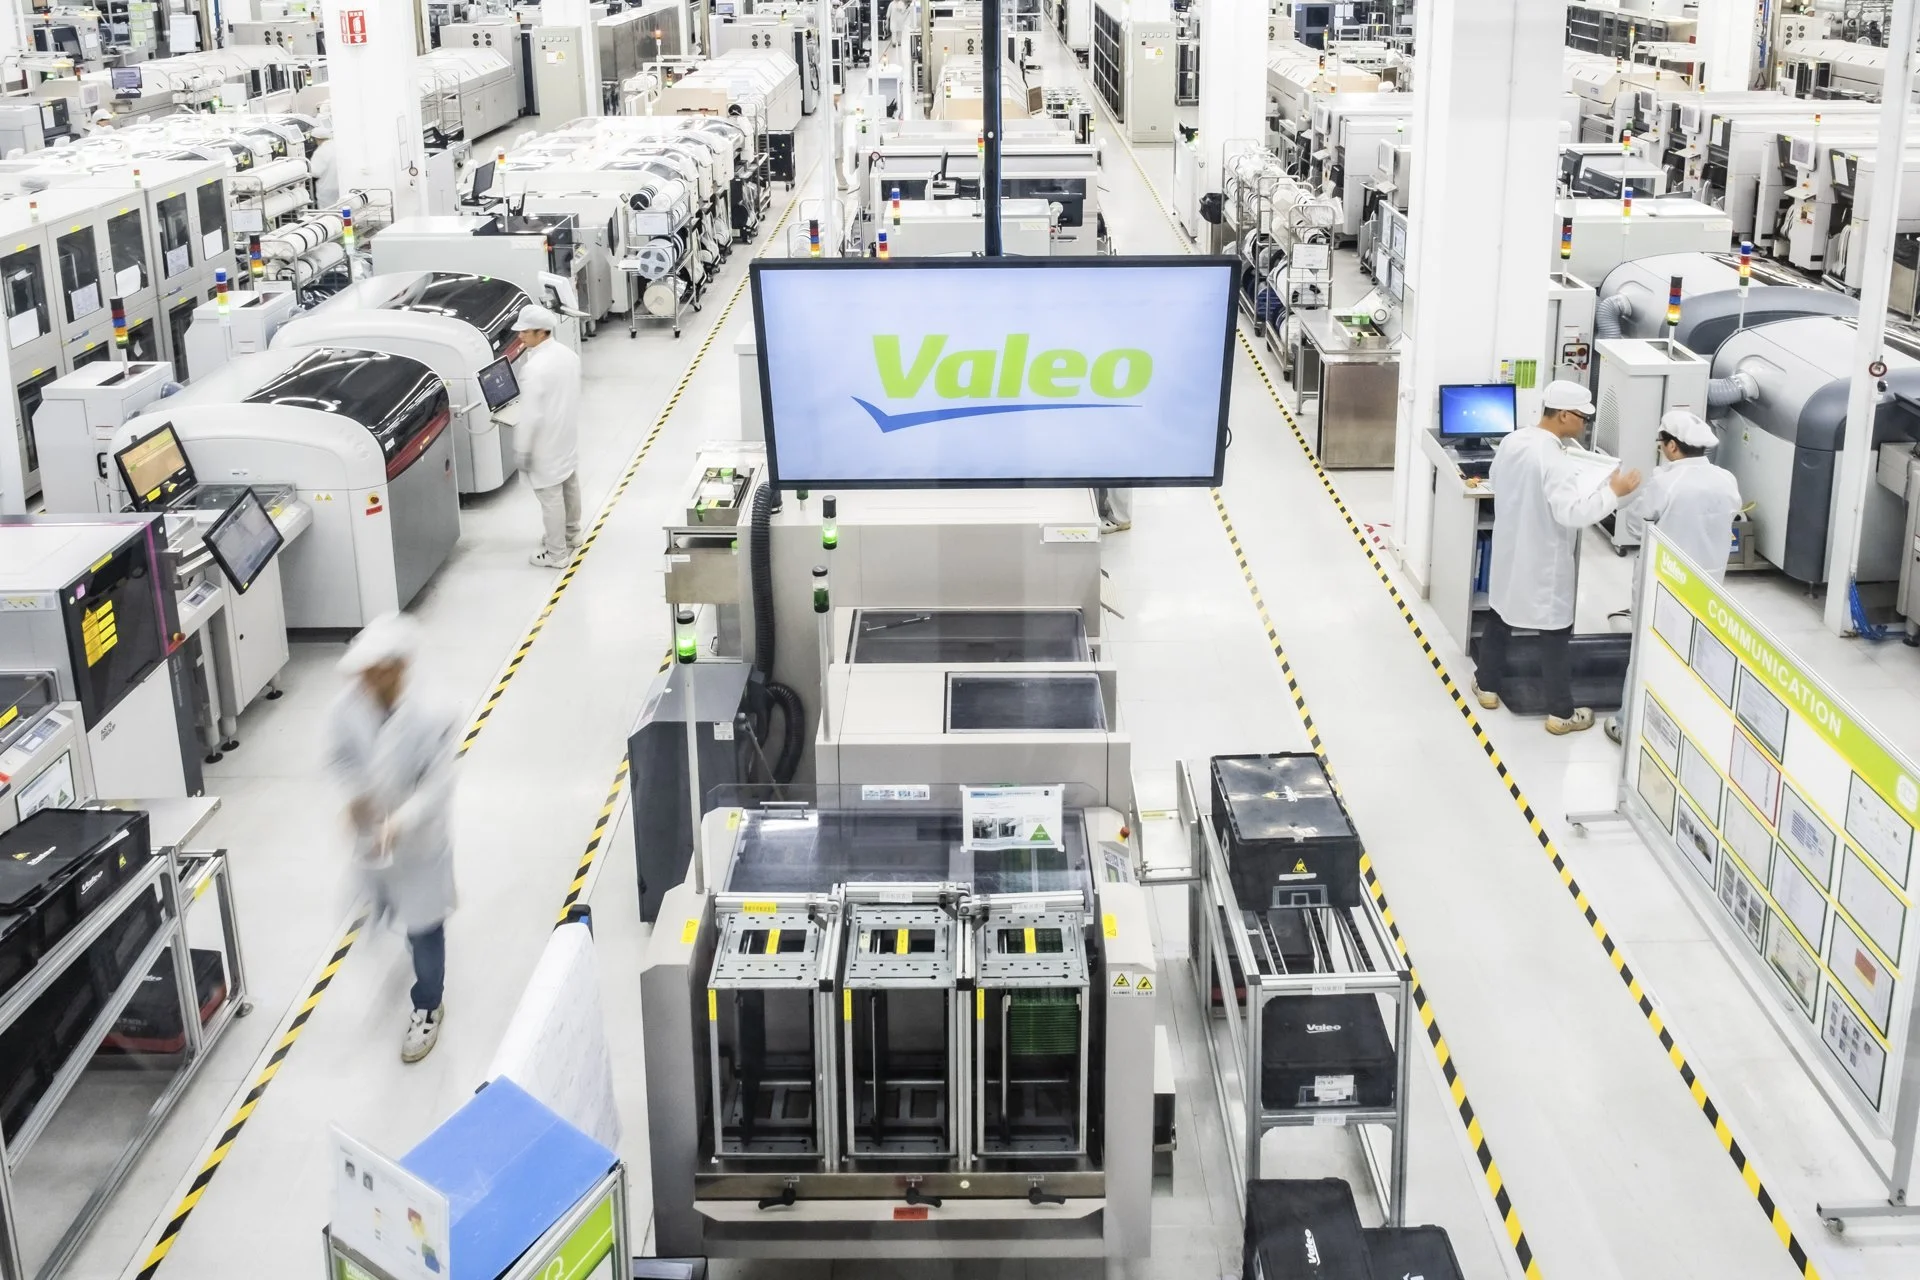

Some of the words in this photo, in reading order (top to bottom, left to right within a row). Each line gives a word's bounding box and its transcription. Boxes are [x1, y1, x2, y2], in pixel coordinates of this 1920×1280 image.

[873, 333, 1153, 399] Valeo
[1708, 599, 1842, 739] COMMUNICATION
[1306, 1023, 1342, 1033] Valeo
[1304, 1228, 1320, 1266] Valeo
